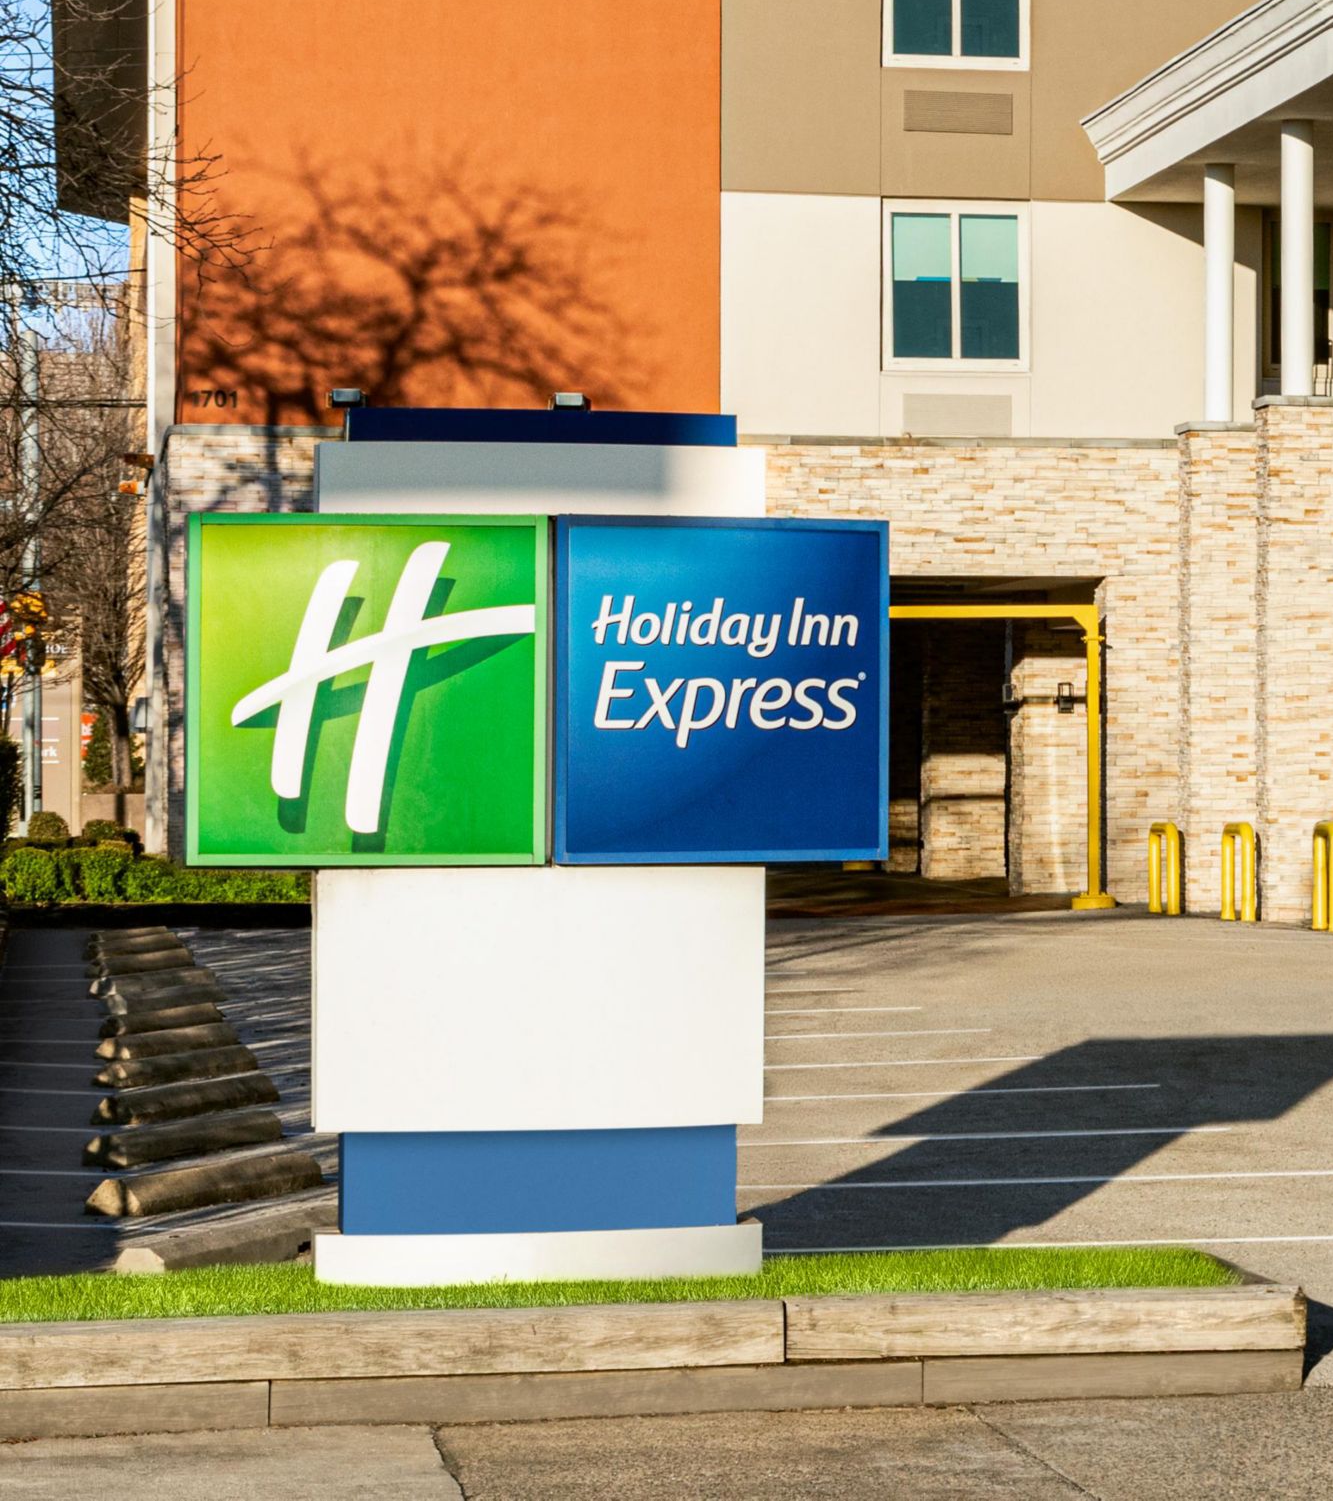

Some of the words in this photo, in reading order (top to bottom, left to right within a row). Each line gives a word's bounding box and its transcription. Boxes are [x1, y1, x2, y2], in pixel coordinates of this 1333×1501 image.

[192, 390, 237, 408] 1701
[592, 595, 782, 658] Holiday
[787, 597, 859, 647] Inn
